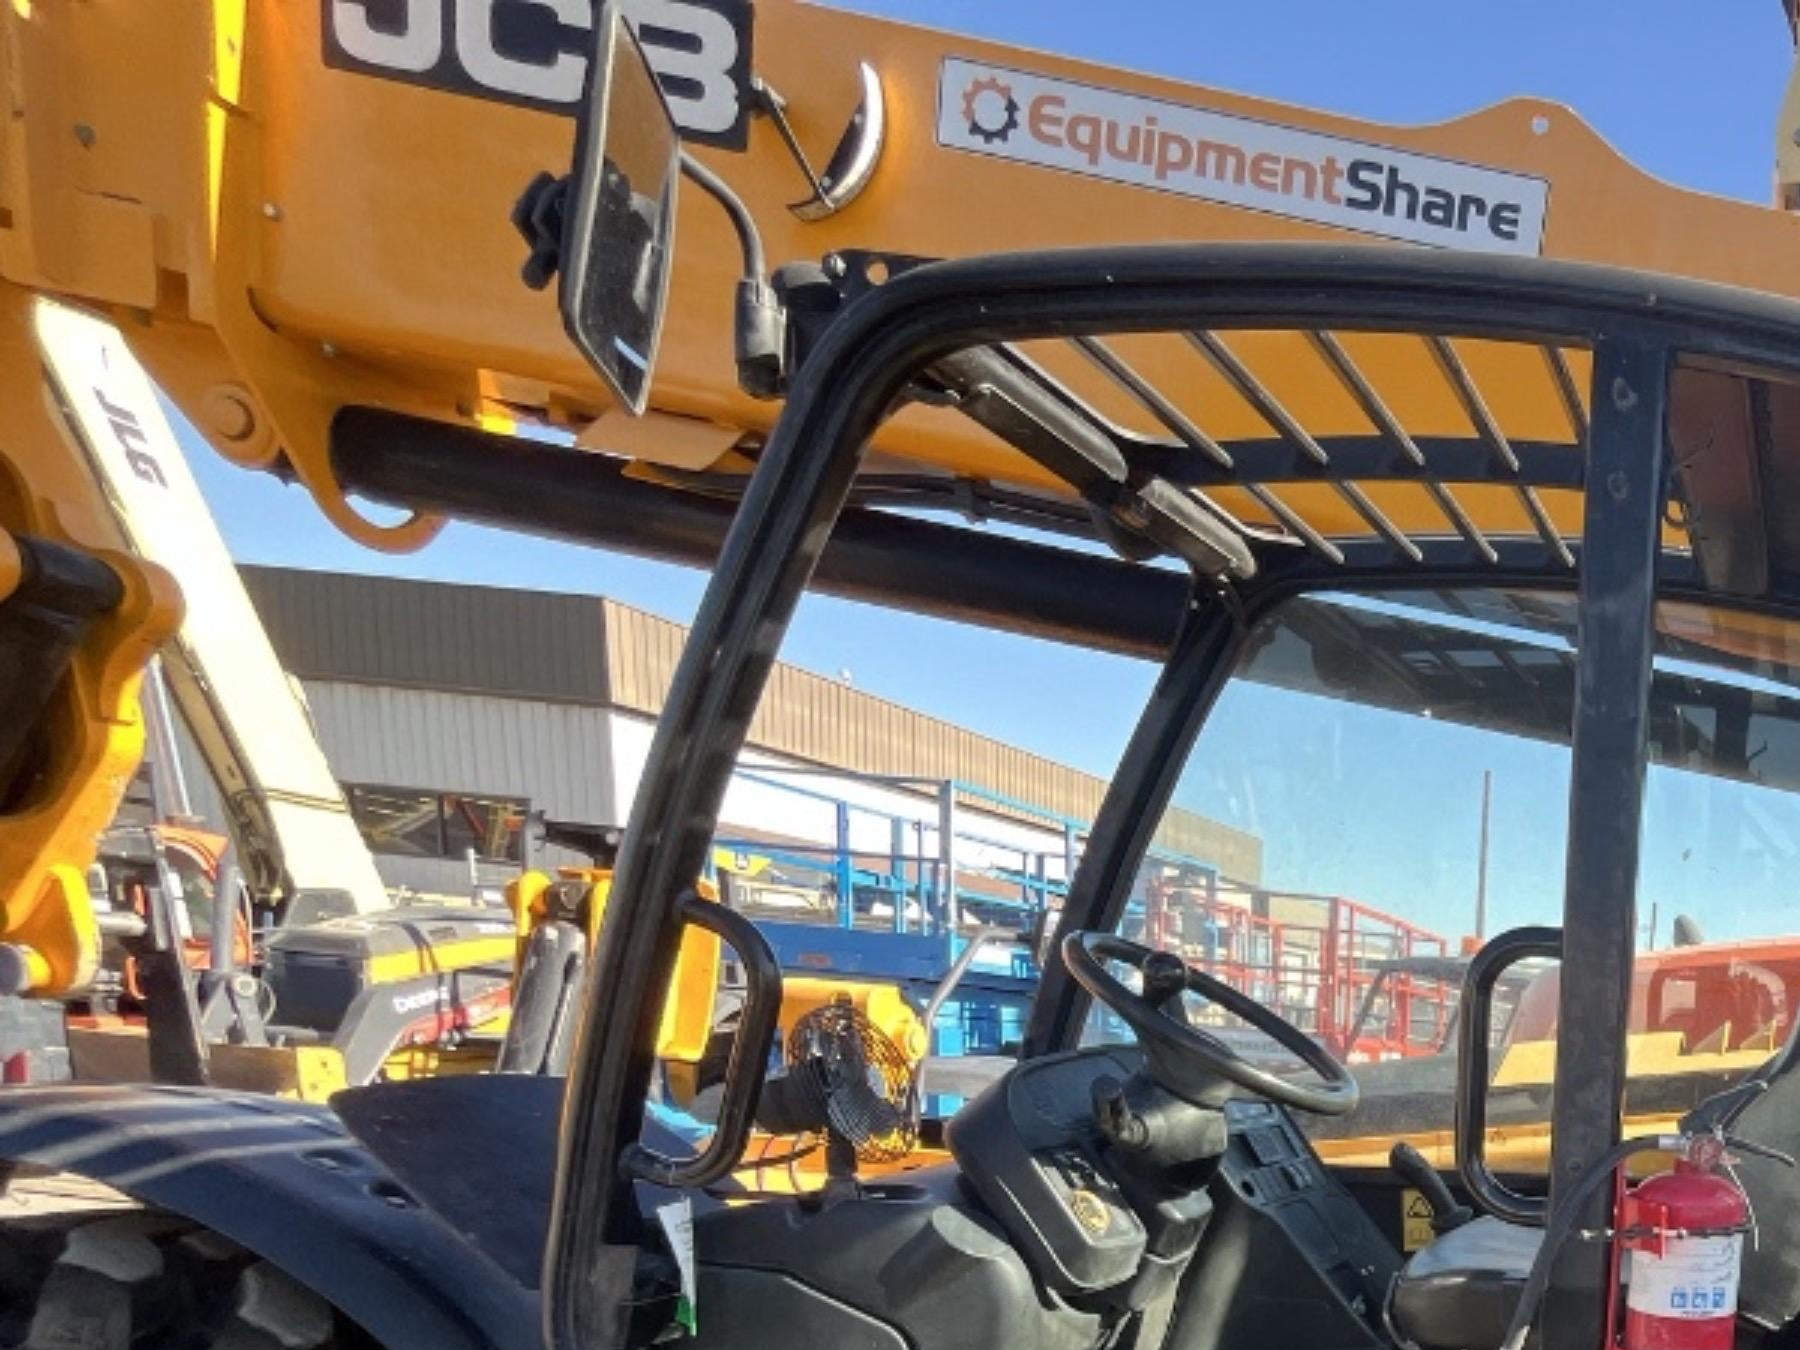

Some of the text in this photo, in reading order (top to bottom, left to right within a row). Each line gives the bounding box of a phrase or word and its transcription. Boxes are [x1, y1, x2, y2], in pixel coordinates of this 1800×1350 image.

[333, 0, 739, 133] JCB
[1027, 94, 1522, 241] EquipmentShare
[93, 386, 168, 490] JLG
